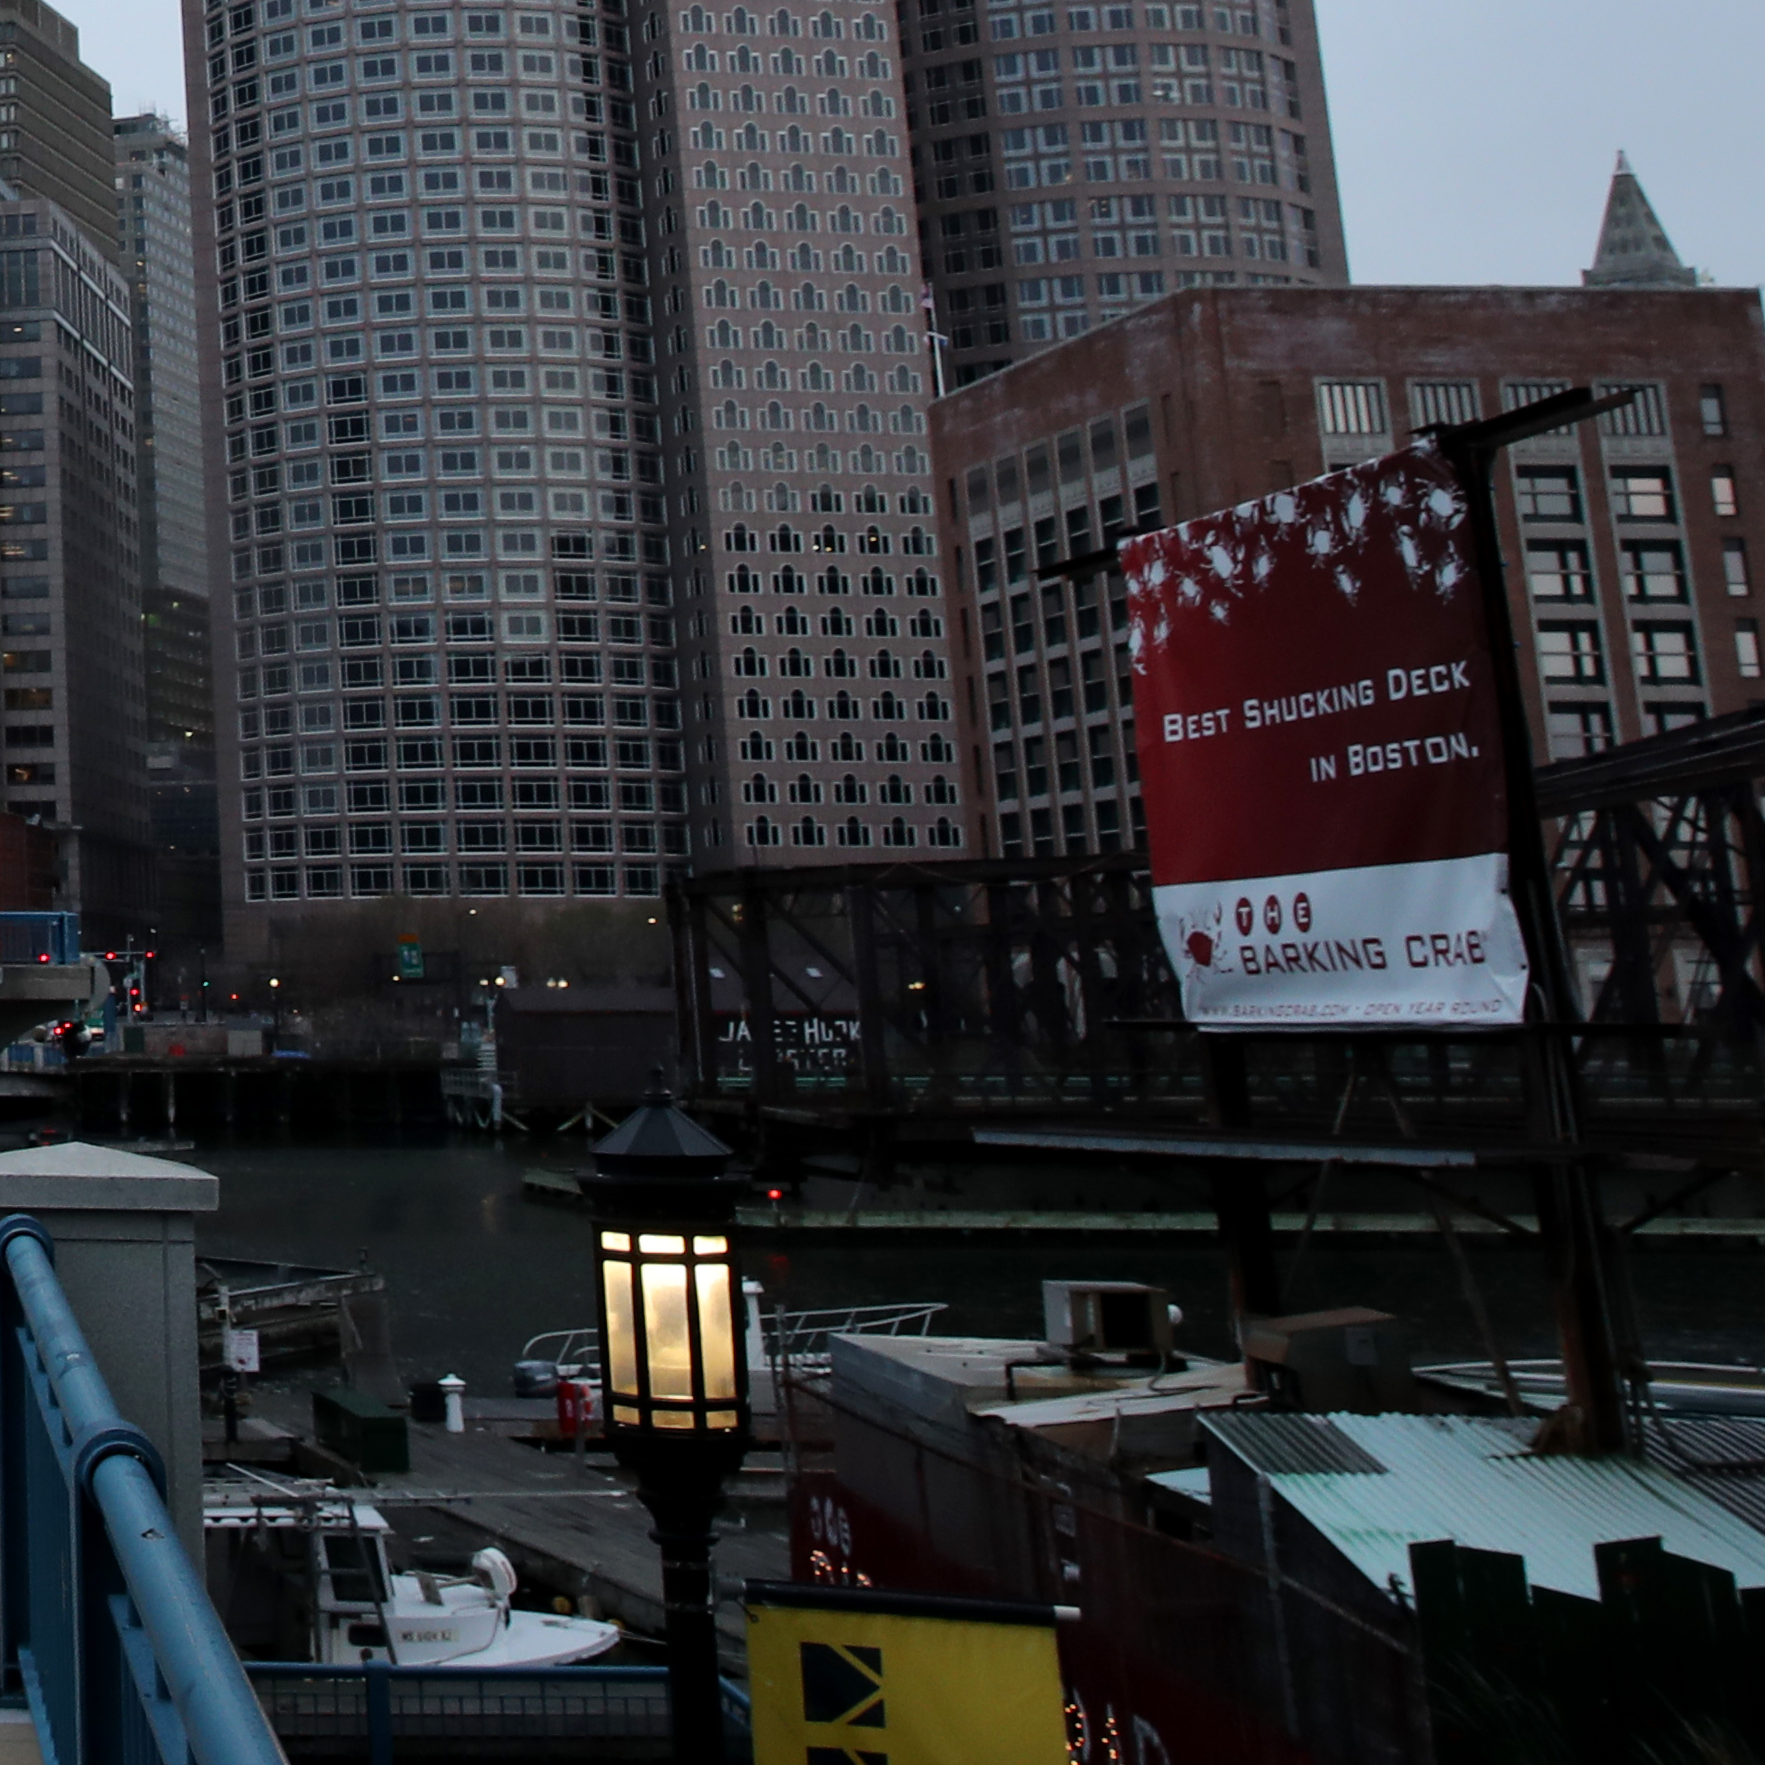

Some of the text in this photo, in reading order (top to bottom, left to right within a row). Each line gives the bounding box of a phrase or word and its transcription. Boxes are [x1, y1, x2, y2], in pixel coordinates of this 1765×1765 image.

[1163, 660, 1471, 742] BEST SHUCKING DECK
[1310, 732, 1480, 782] IN BOSTON.
[1237, 900, 1310, 929] THE
[1239, 930, 1485, 975] BARKING CRAB
[1364, 1002, 1400, 1016] OPEN
[1410, 1001, 1445, 1015] YEAR
[1451, 999, 1503, 1014] ROUND
